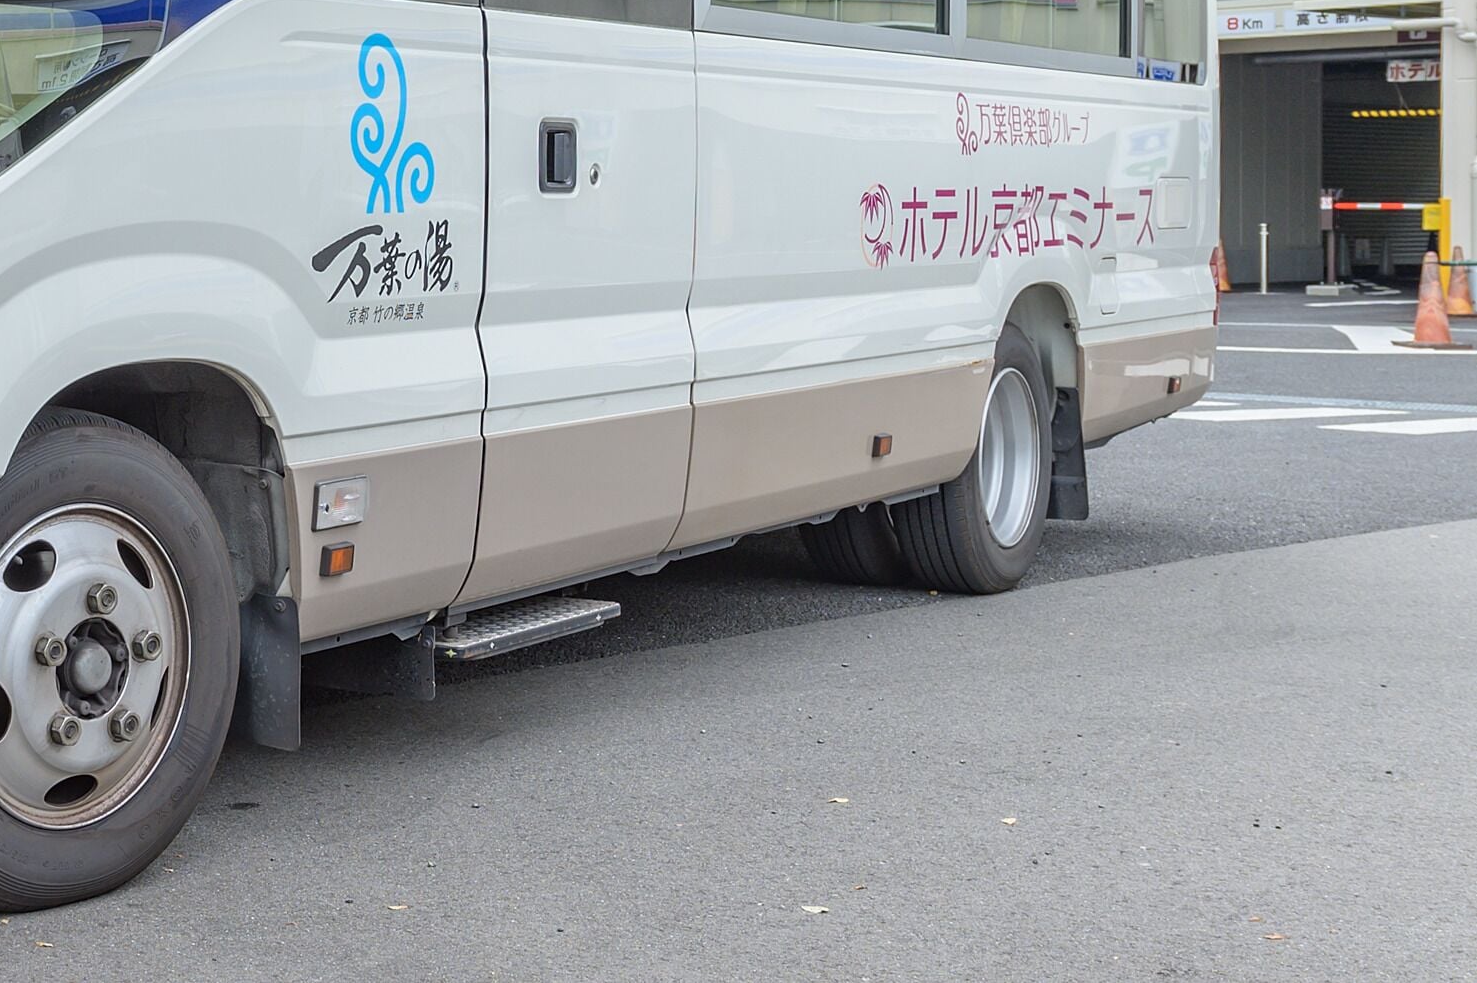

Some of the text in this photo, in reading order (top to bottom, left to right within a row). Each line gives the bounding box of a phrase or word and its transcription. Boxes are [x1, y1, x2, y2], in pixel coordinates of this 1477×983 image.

[311, 219, 454, 304] 万葉の湯
[899, 184, 1155, 263] ホテル京都エミナース
